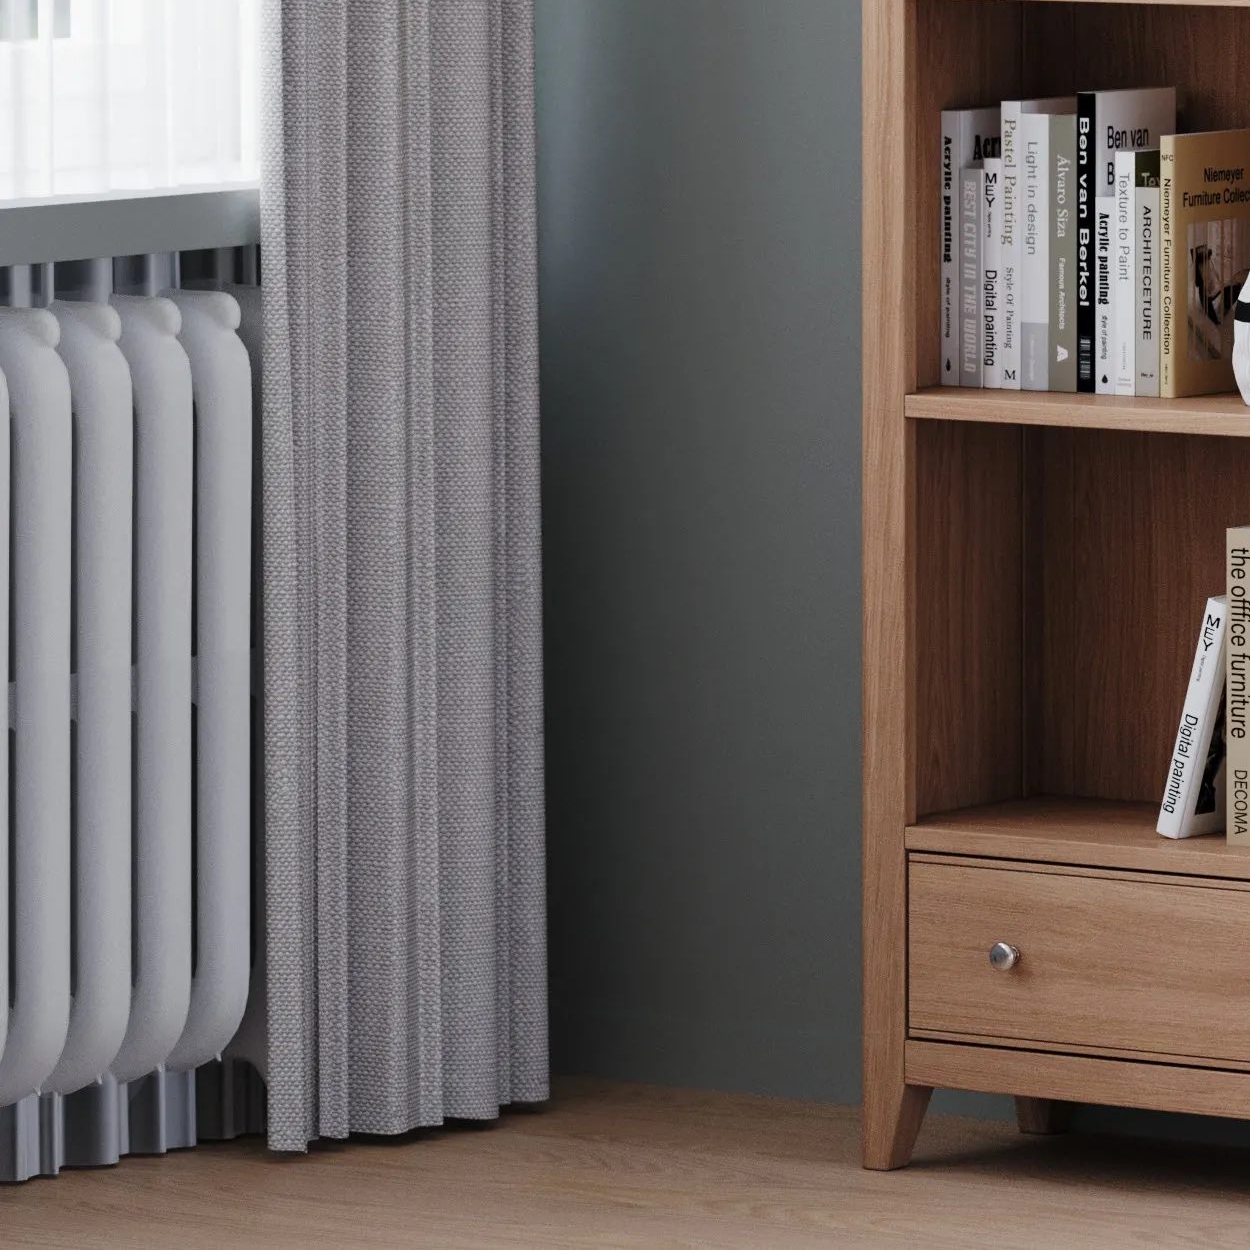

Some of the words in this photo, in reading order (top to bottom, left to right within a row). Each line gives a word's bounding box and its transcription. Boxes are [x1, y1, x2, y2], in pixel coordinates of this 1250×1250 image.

[1003, 119, 1017, 168] Pastel
[1079, 117, 1090, 166] Ben
[1107, 125, 1128, 150] Ben
[1130, 127, 1149, 148] van
[1161, 154, 1174, 162] NFC
[944, 136, 953, 190] Acrylic
[1025, 141, 1039, 180] Light
[1056, 154, 1071, 204] Álvaro
[1203, 167, 1245, 185] Niemeyer
[963, 180, 977, 218] BEST
[1000, 175, 1017, 246] Painting
[1027, 185, 1038, 198] in
[1079, 173, 1089, 219] van
[1119, 173, 1130, 223] Texture
[1162, 178, 1172, 235] Niemeyer
[1182, 190, 1221, 208] Furniture
[943, 195, 953, 263] painting
[963, 222, 977, 259] CITY
[1025, 204, 1038, 255] design
[1056, 208, 1069, 238] Siza
[1097, 212, 1110, 252] Acrylic
[1119, 228, 1130, 241] to
[1004, 267, 1014, 291] Style
[1058, 258, 1067, 290] Famous
[1079, 228, 1090, 307] Berkel
[1097, 255, 1110, 305] painting
[1119, 246, 1130, 282] Paint
[1142, 205, 1152, 340] ARCHITECETURE
[1163, 239, 1173, 292] Furniture
[963, 284, 977, 315] THE
[983, 270, 998, 310] Digital
[1005, 293, 1014, 307] Of
[1058, 291, 1067, 330] Architects
[963, 318, 977, 374] WORLD
[983, 315, 998, 366] painting
[1003, 310, 1014, 349] Painting
[1163, 296, 1173, 356] Collection
[1177, 714, 1199, 758] Digital
[1162, 758, 1185, 814] painting
[1234, 769, 1248, 835] DECOMA
